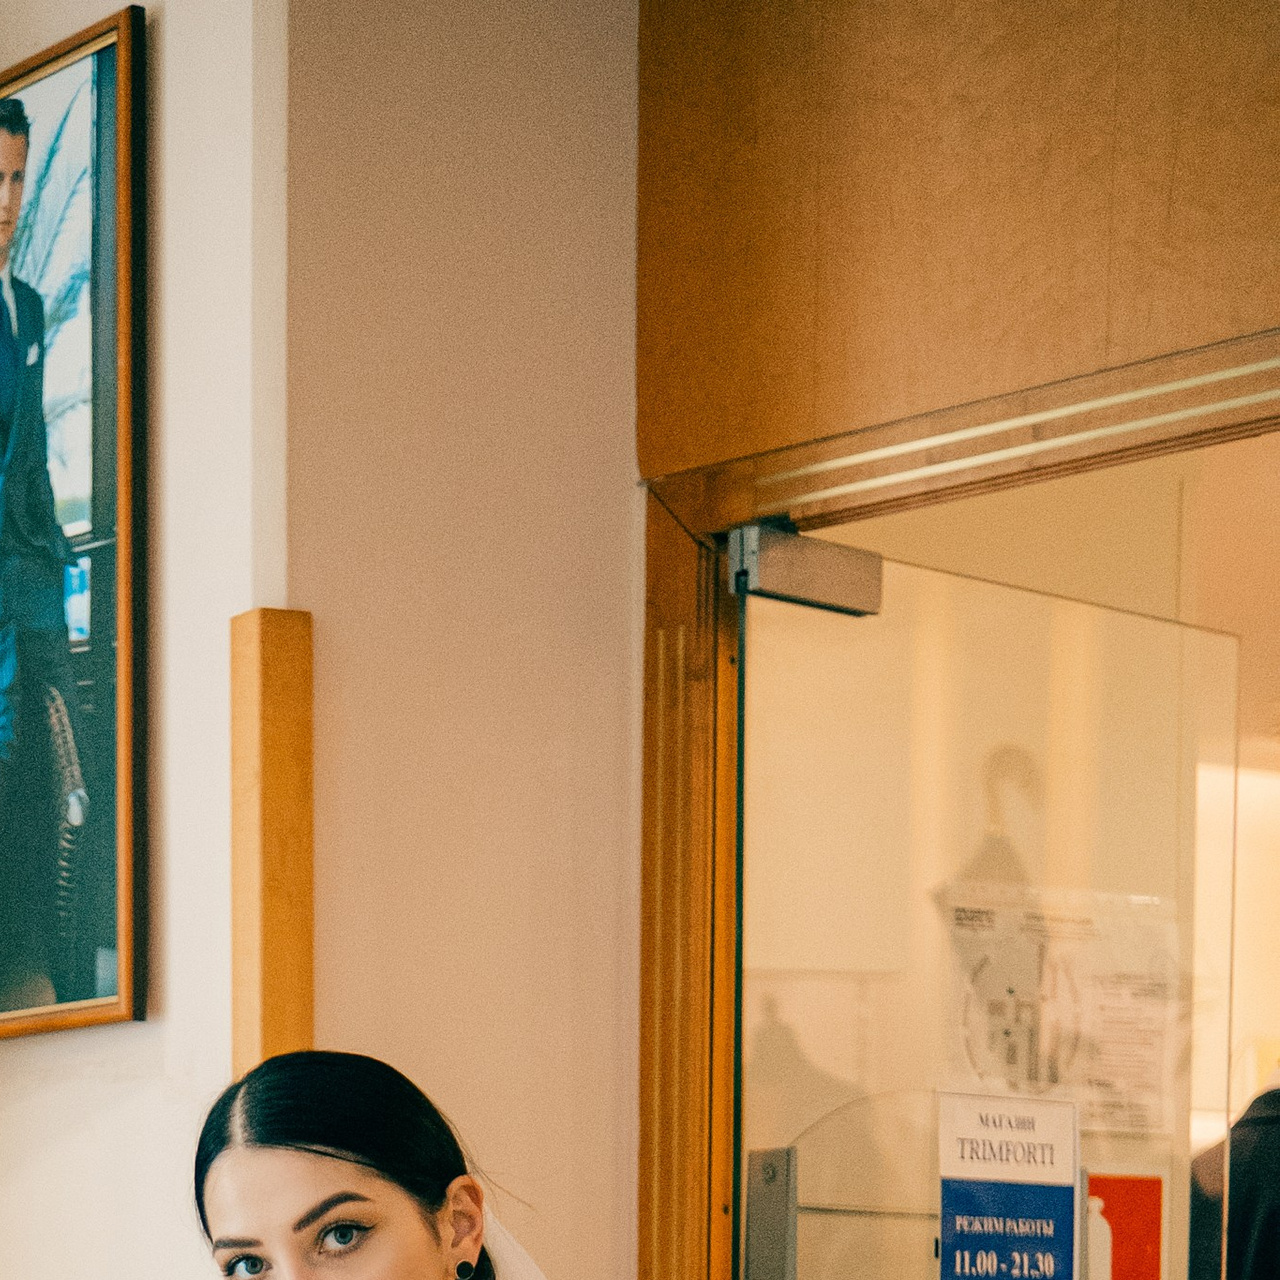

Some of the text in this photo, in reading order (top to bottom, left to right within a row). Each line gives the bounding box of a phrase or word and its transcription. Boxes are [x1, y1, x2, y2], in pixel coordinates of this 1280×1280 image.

[979, 1112, 1036, 1131] МАГАЗИН
[958, 1137, 1055, 1166] TRIMFORTI
[955, 1215, 1054, 1238] РЕЖИМ РАБОТЫ
[955, 1250, 998, 1277] 11.00
[1011, 1251, 1055, 1279] 21.30
